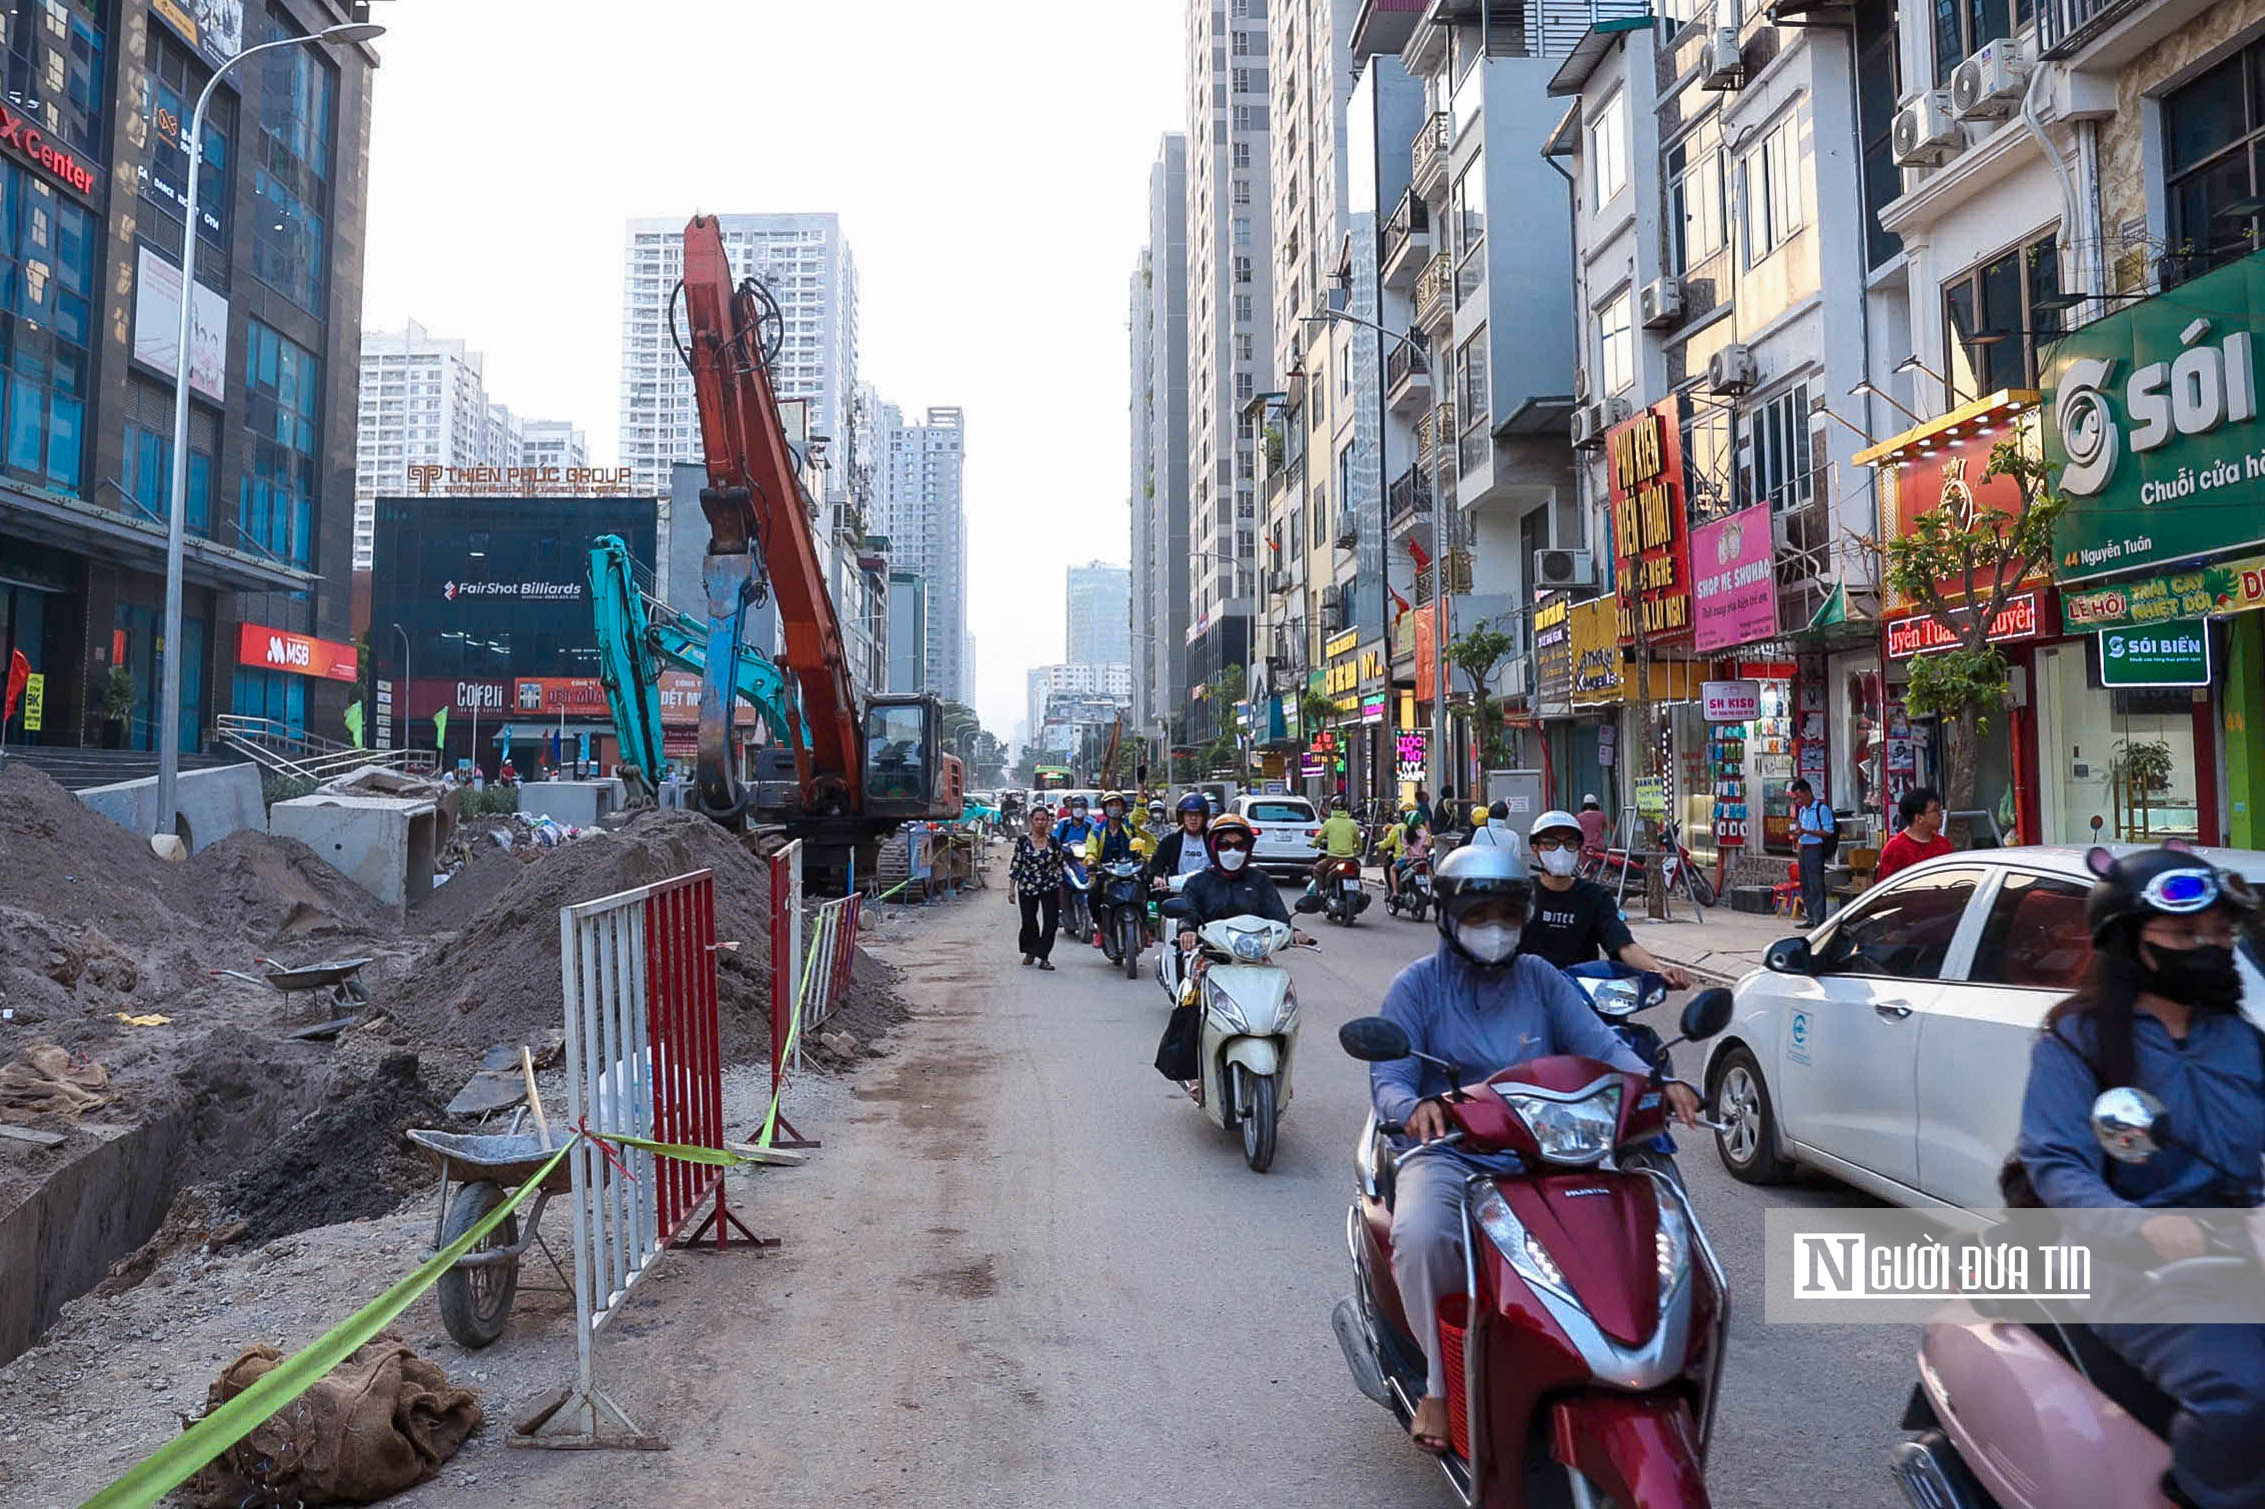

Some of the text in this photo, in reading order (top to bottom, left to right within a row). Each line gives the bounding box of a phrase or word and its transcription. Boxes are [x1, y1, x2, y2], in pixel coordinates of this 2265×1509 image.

[24, 128, 94, 194] Center
[153, 177, 175, 199] DANCE
[445, 462, 631, 483] THIÊN PHÚC GROUP
[2141, 466, 2195, 505] Chuỗi
[2200, 458, 2240, 490] cửa
[2064, 535, 2152, 567] 44 Nguyễn Tuân
[458, 581, 581, 595] FairShot Billiards
[1697, 575, 1719, 600] SHOP
[2092, 593, 2126, 618] HỘI
[286, 642, 310, 666] MSB
[2129, 634, 2200, 654] SÓI BIỂN
[661, 688, 684, 708] DỆT
[1709, 698, 1724, 709] SH
